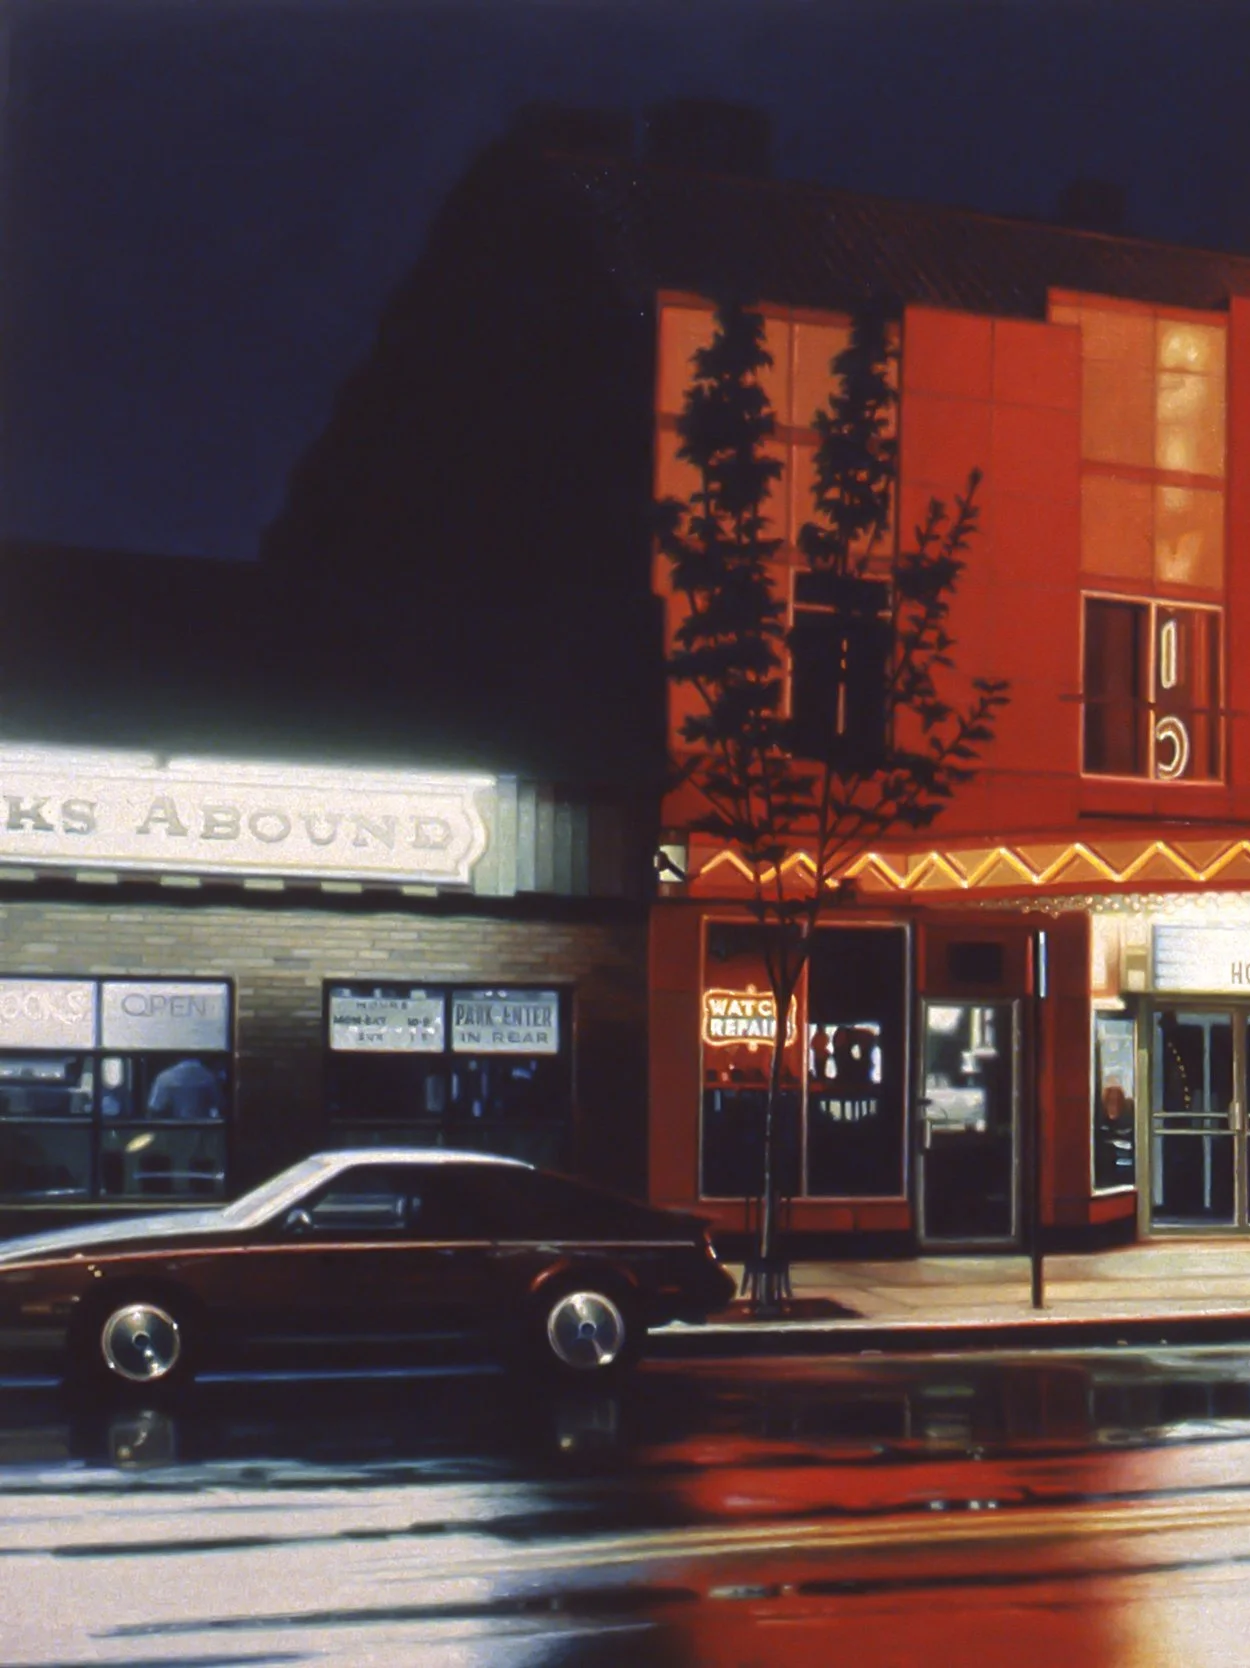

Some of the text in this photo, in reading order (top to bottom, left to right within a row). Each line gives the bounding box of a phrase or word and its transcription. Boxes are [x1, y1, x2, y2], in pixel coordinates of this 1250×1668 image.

[136, 796, 454, 850] ABOUND
[121, 993, 208, 1018] OPEN
[503, 1004, 553, 1028] ENTER
[708, 999, 786, 1016] WATC
[461, 1031, 480, 1043] IN
